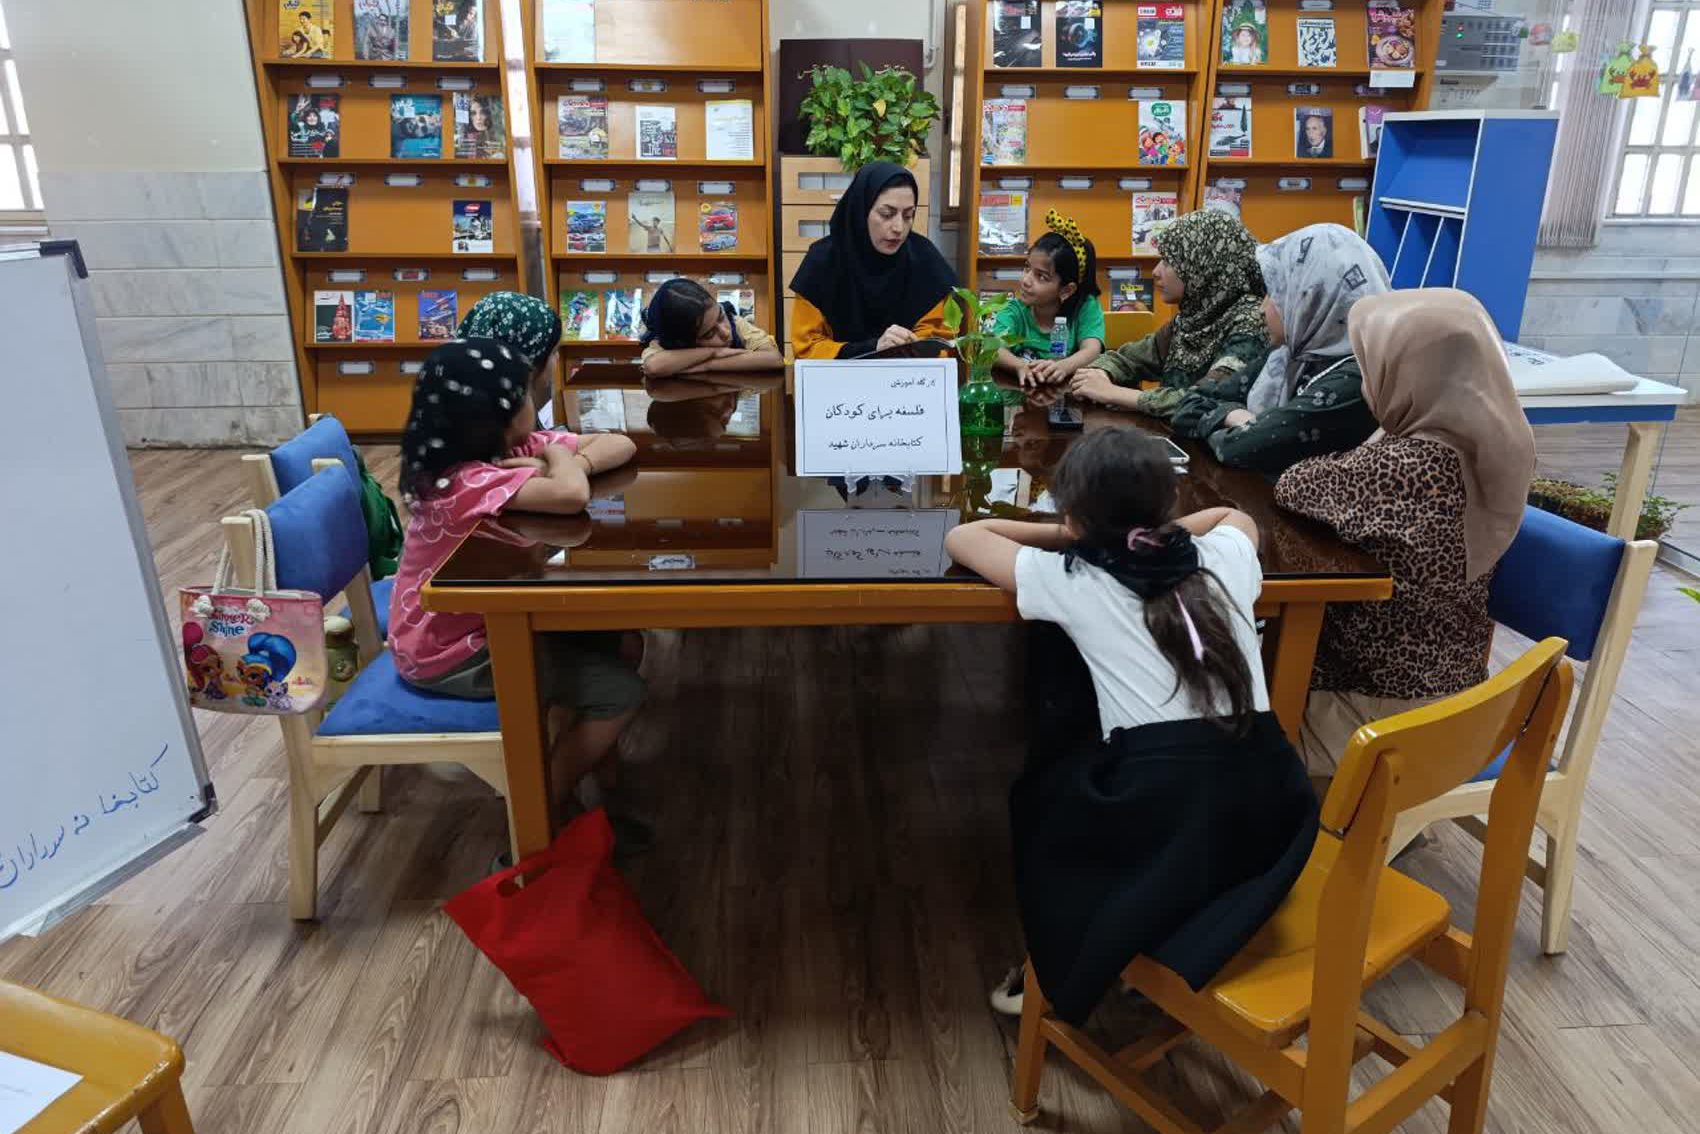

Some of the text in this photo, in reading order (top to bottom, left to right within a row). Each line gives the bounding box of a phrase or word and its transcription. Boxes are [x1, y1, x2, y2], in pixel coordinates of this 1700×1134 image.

[825, 402, 925, 420] فلسفه برای کودکان
[828, 435, 924, 450] کتابخانه سرداران شهید
